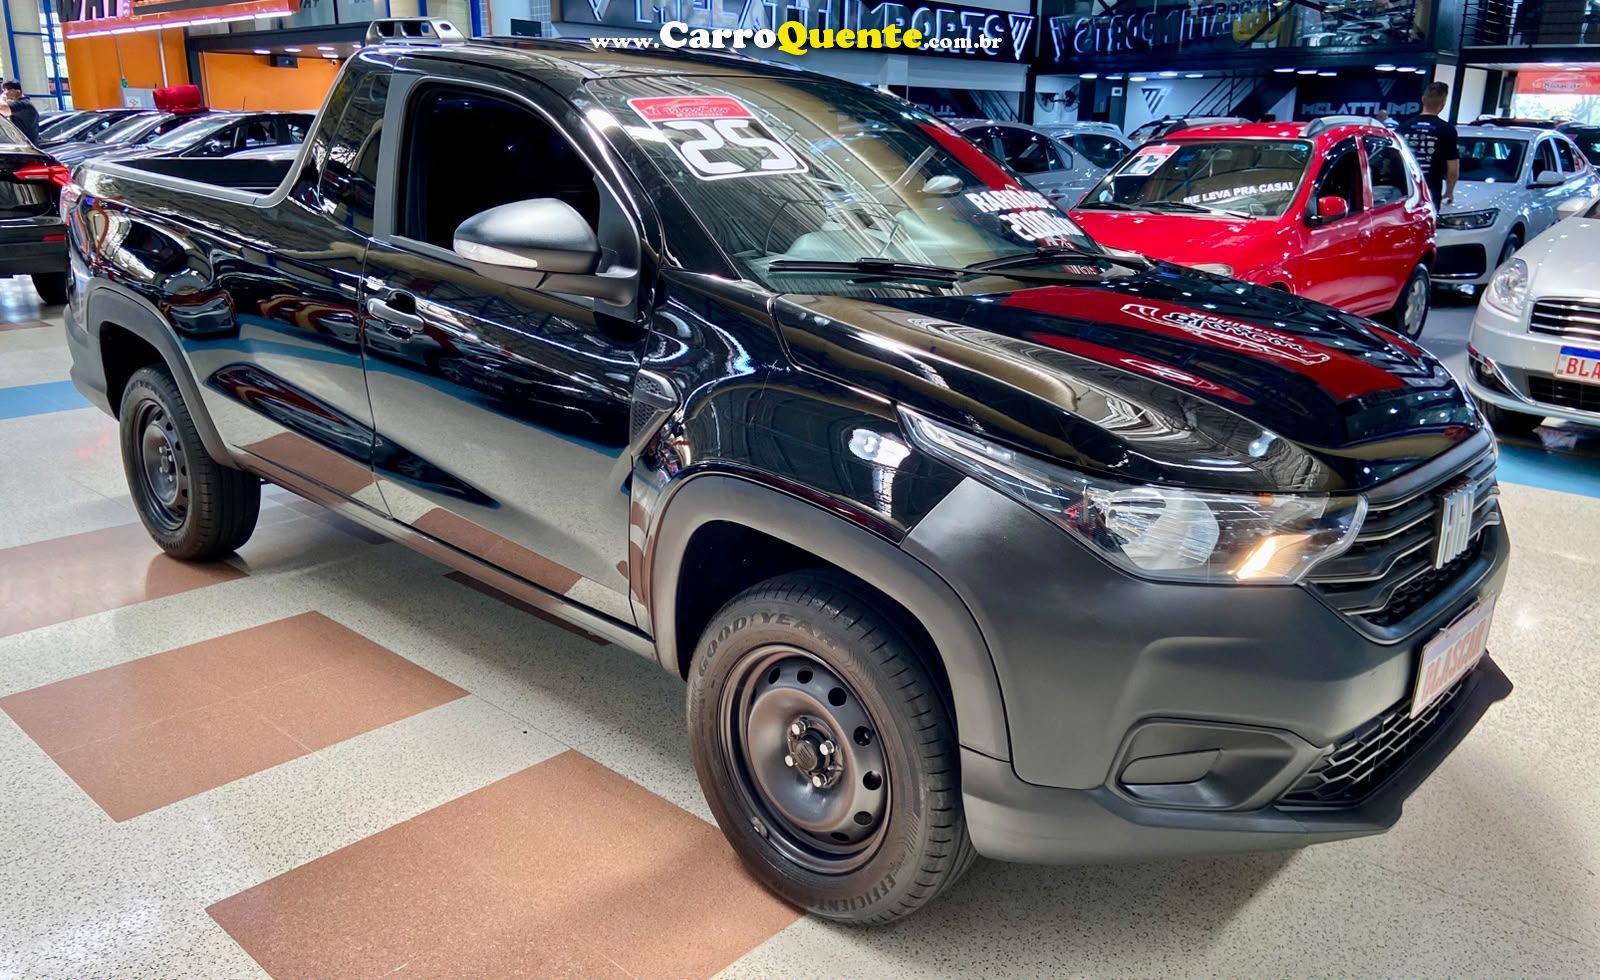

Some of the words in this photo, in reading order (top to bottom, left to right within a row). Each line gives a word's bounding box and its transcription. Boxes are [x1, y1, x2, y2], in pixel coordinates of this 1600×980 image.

[662, 119, 798, 174] 25
[1203, 189, 1231, 201] LEVA
[1234, 185, 1257, 196] PRA
[1259, 181, 1293, 193] CASA!
